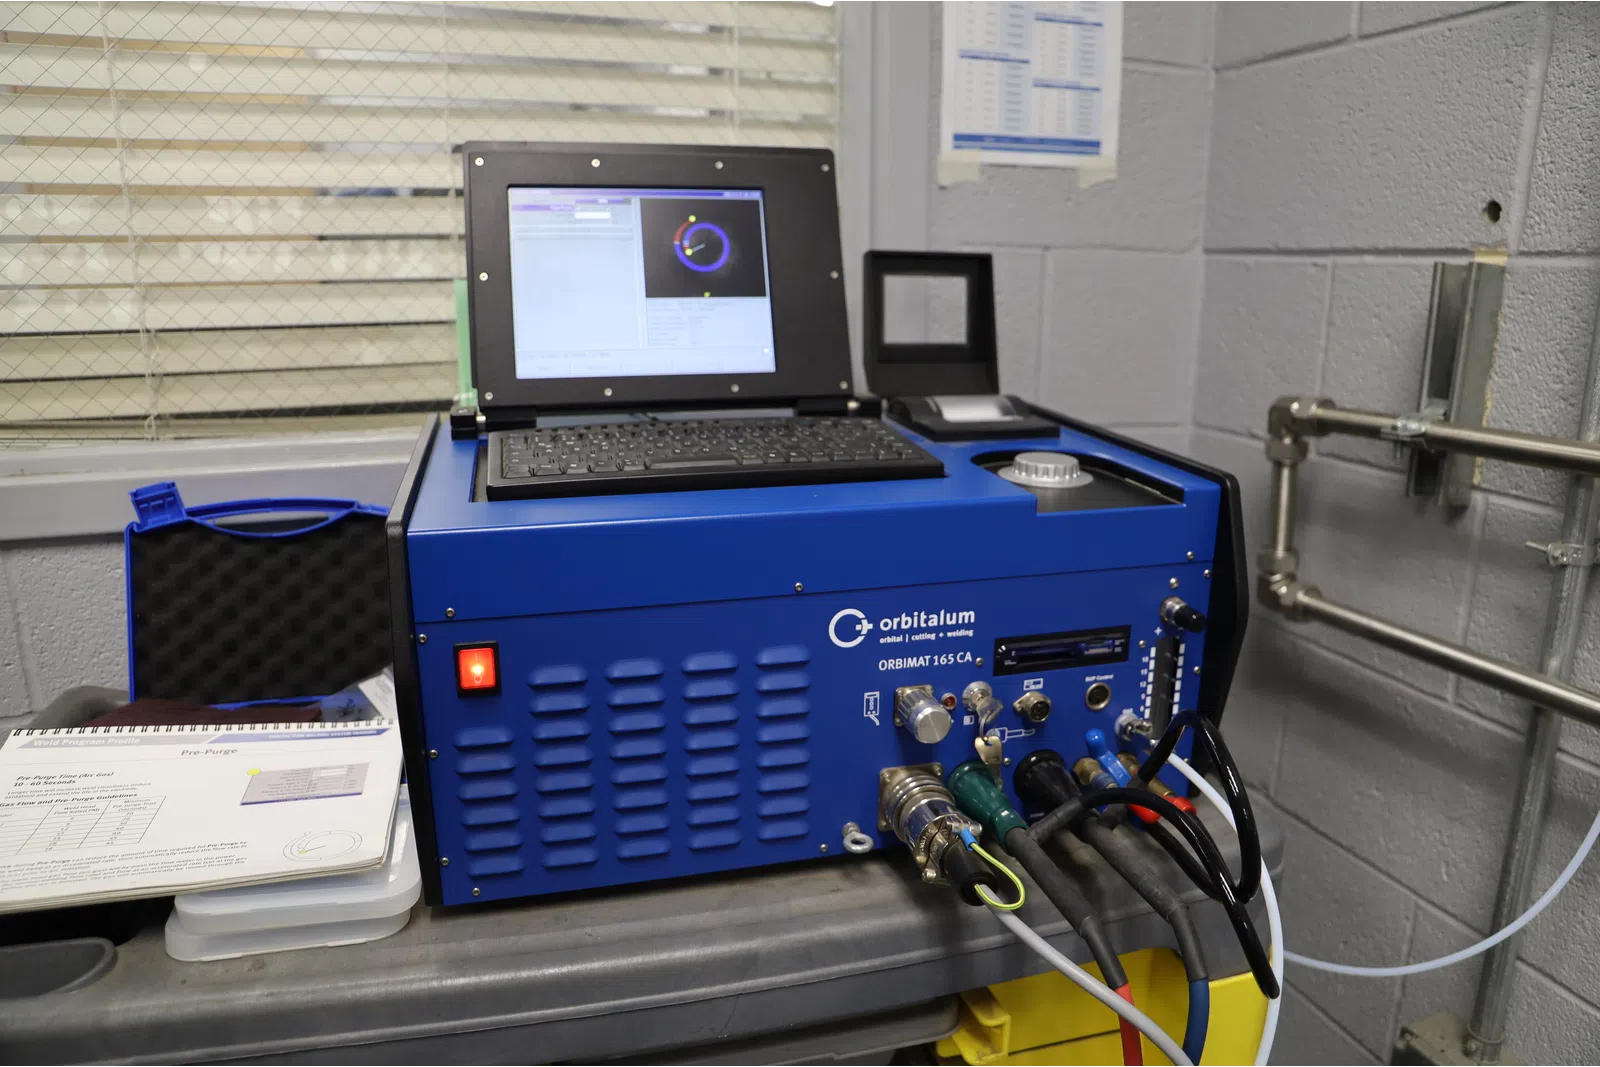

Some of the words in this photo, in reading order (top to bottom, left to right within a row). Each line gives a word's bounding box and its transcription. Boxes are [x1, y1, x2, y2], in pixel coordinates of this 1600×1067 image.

[880, 609, 975, 631] orbitalum
[880, 634, 903, 644] orbital
[947, 629, 974, 637] welding
[878, 655, 931, 671] ORBIMAT
[932, 654, 954, 666] 165
[956, 652, 972, 663] CA
[180, 748, 238, 756] Pre-Purge
